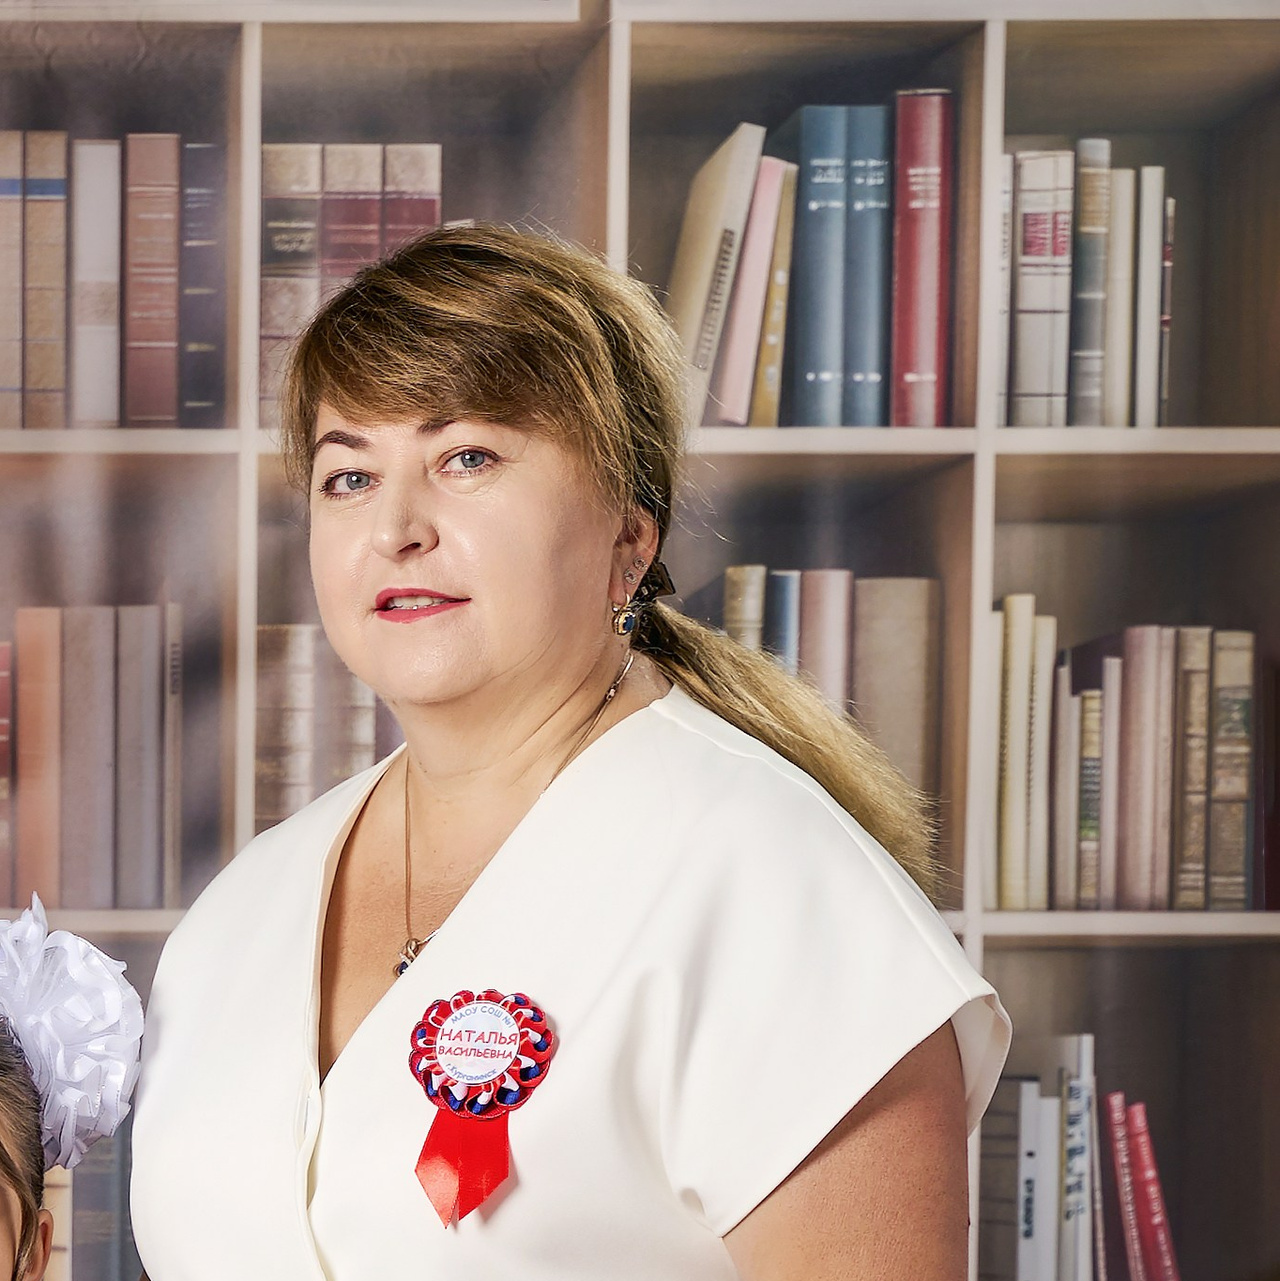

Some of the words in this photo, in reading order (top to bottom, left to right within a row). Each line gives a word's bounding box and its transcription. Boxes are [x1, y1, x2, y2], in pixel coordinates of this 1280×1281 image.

[451, 1006, 478, 1024] МАОУ
[480, 1005, 504, 1019] СОШ
[440, 1028, 519, 1046] НАТАЛЬЯ
[438, 1045, 513, 1060] ВАСИЛЬЕВНА
